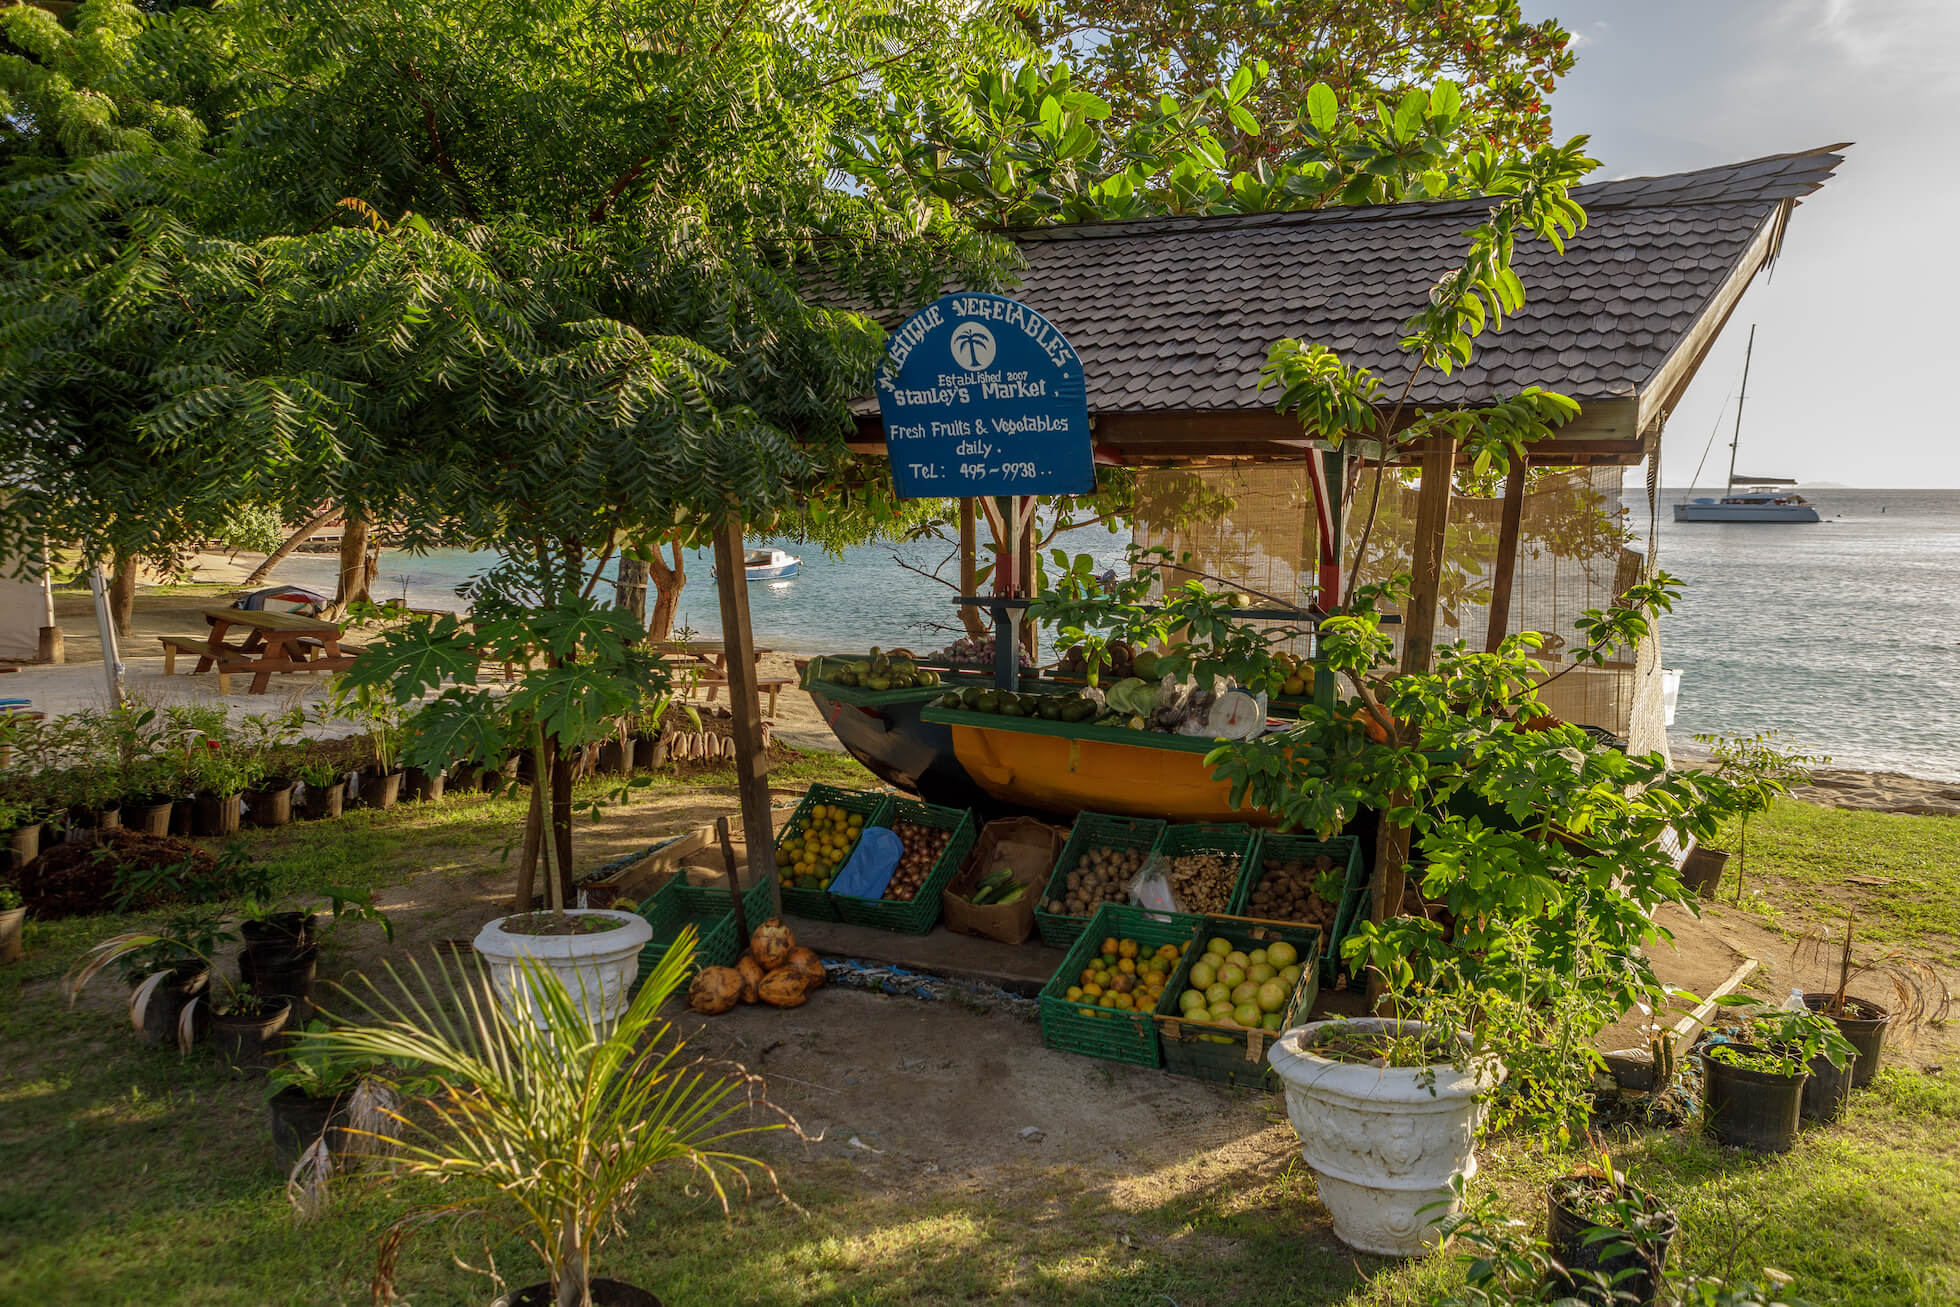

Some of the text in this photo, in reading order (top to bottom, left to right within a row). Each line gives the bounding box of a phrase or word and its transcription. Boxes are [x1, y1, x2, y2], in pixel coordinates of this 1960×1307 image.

[1006, 370, 1029, 382] 2007
[890, 424, 926, 440] Fresh
[931, 420, 972, 437] Fruits
[975, 418, 989, 435] &
